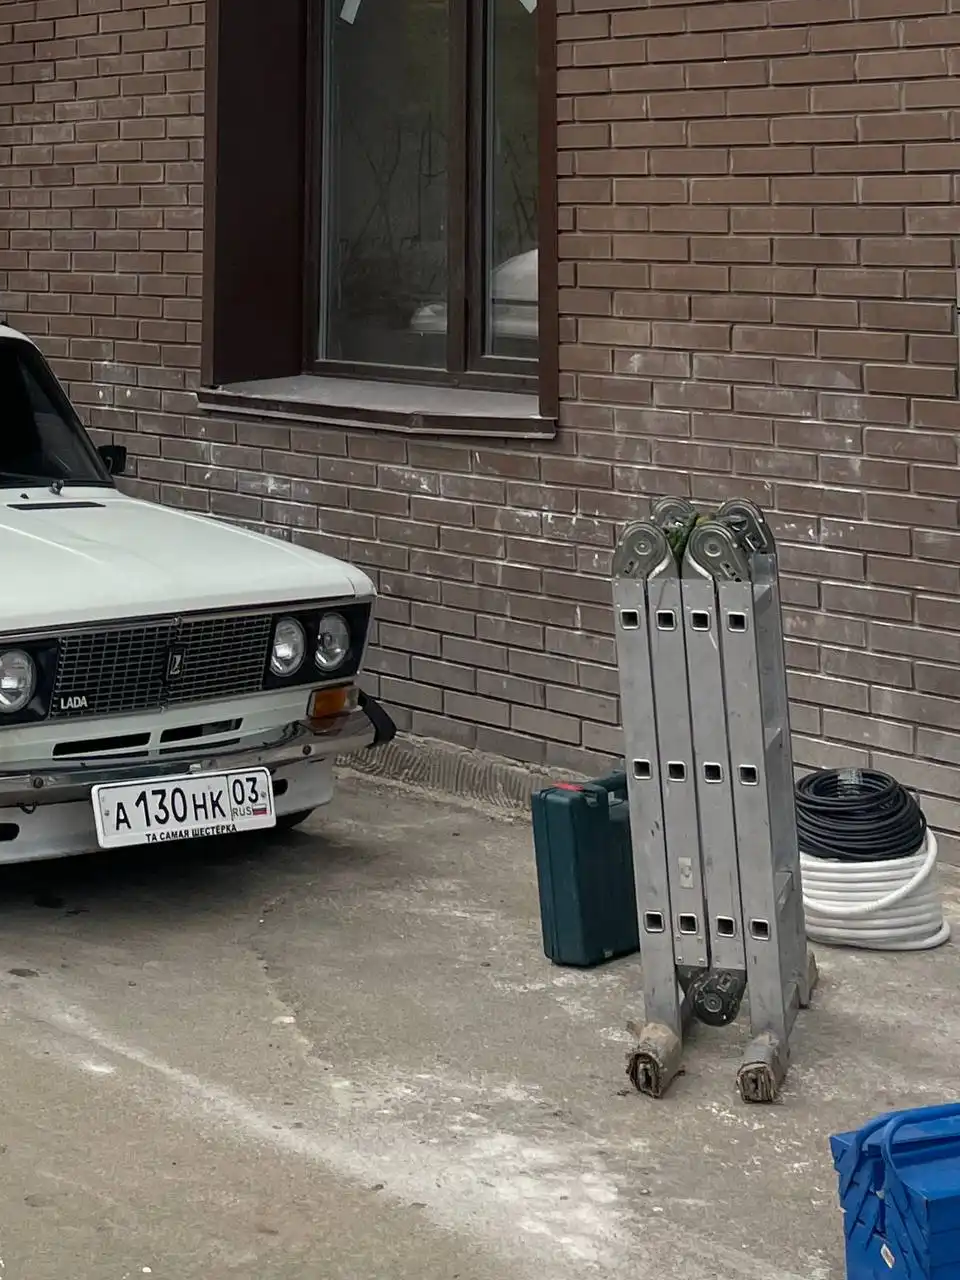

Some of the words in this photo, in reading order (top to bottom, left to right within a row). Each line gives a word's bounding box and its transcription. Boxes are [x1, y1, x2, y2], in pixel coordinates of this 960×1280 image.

[60, 695, 88, 709] LADA
[232, 777, 259, 805] 03
[232, 805, 252, 817] RUS
[145, 833, 158, 843] ТА
[159, 829, 190, 841] САМАЯ
